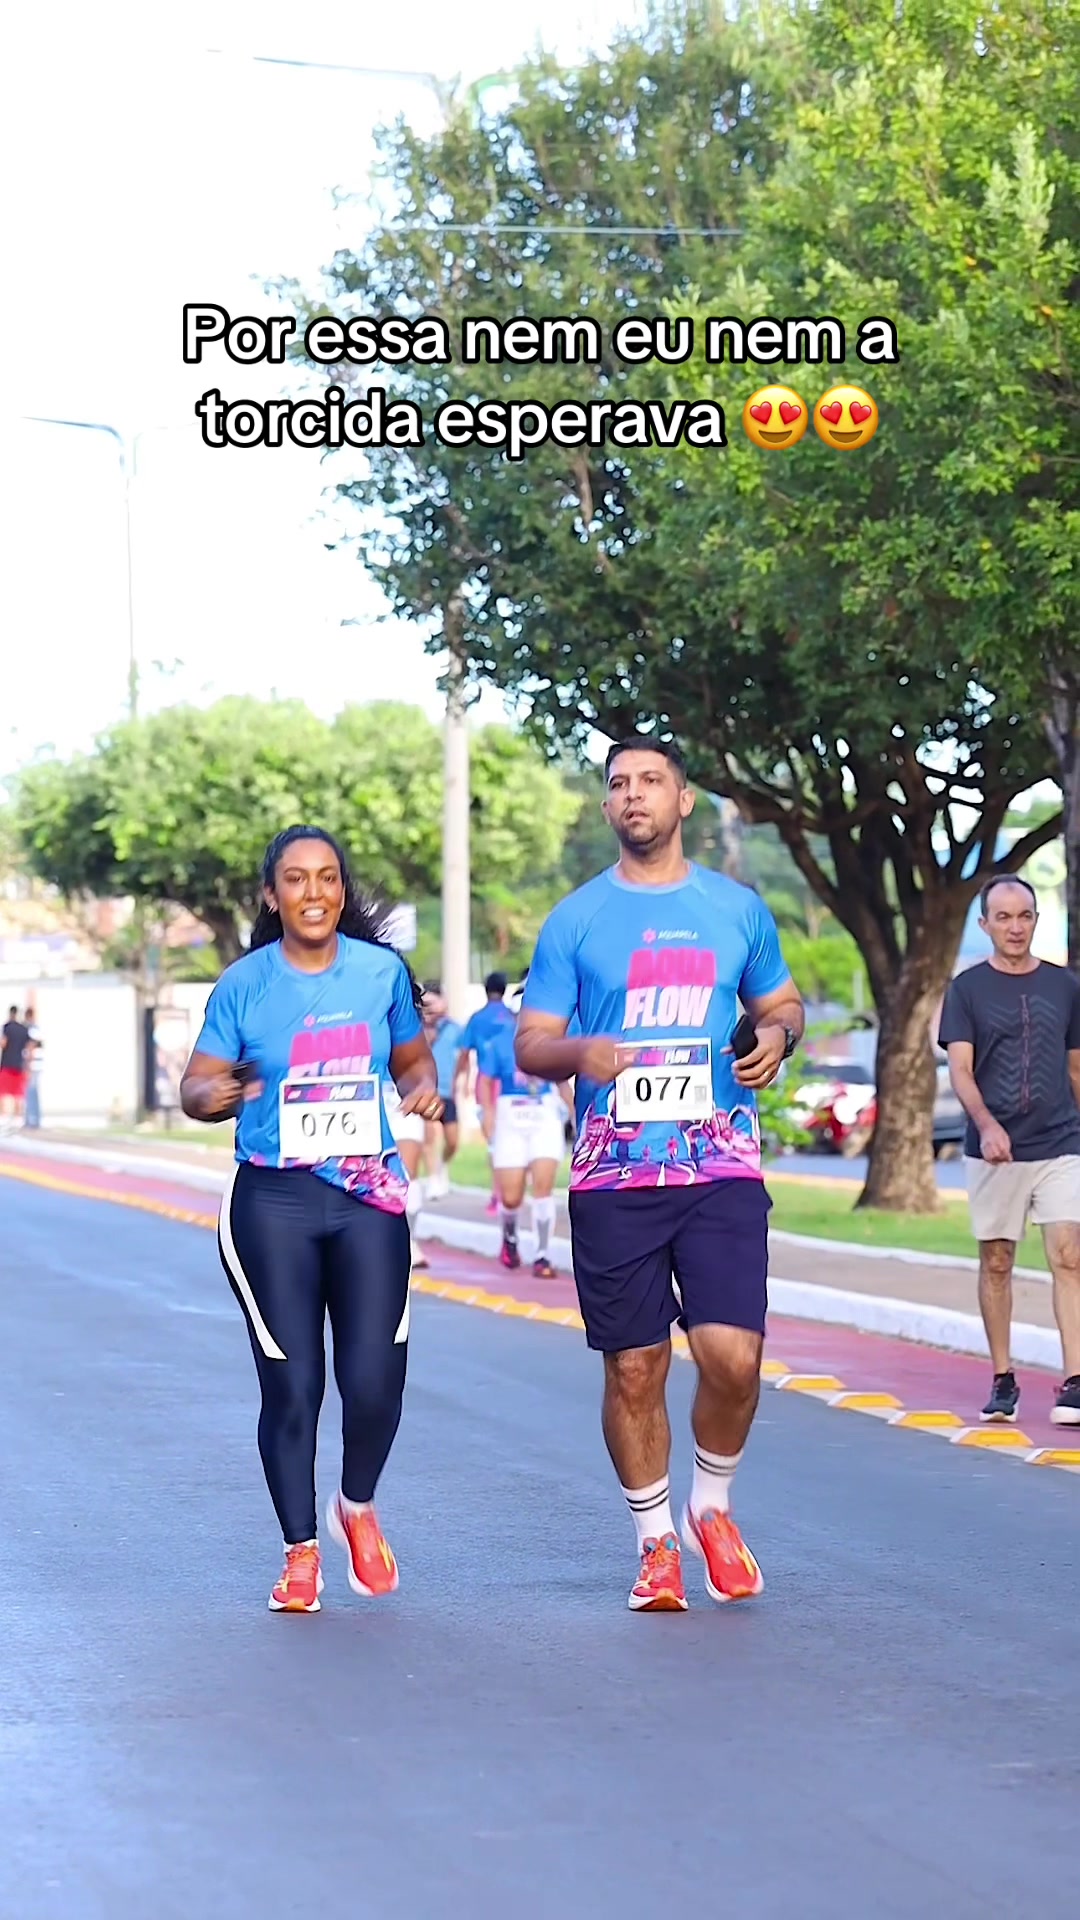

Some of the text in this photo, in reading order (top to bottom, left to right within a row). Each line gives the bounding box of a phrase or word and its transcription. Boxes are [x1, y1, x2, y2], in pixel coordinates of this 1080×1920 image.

[622, 985, 714, 1030] FLOW
[635, 1076, 691, 1102] 077
[301, 1111, 357, 1137] 076
